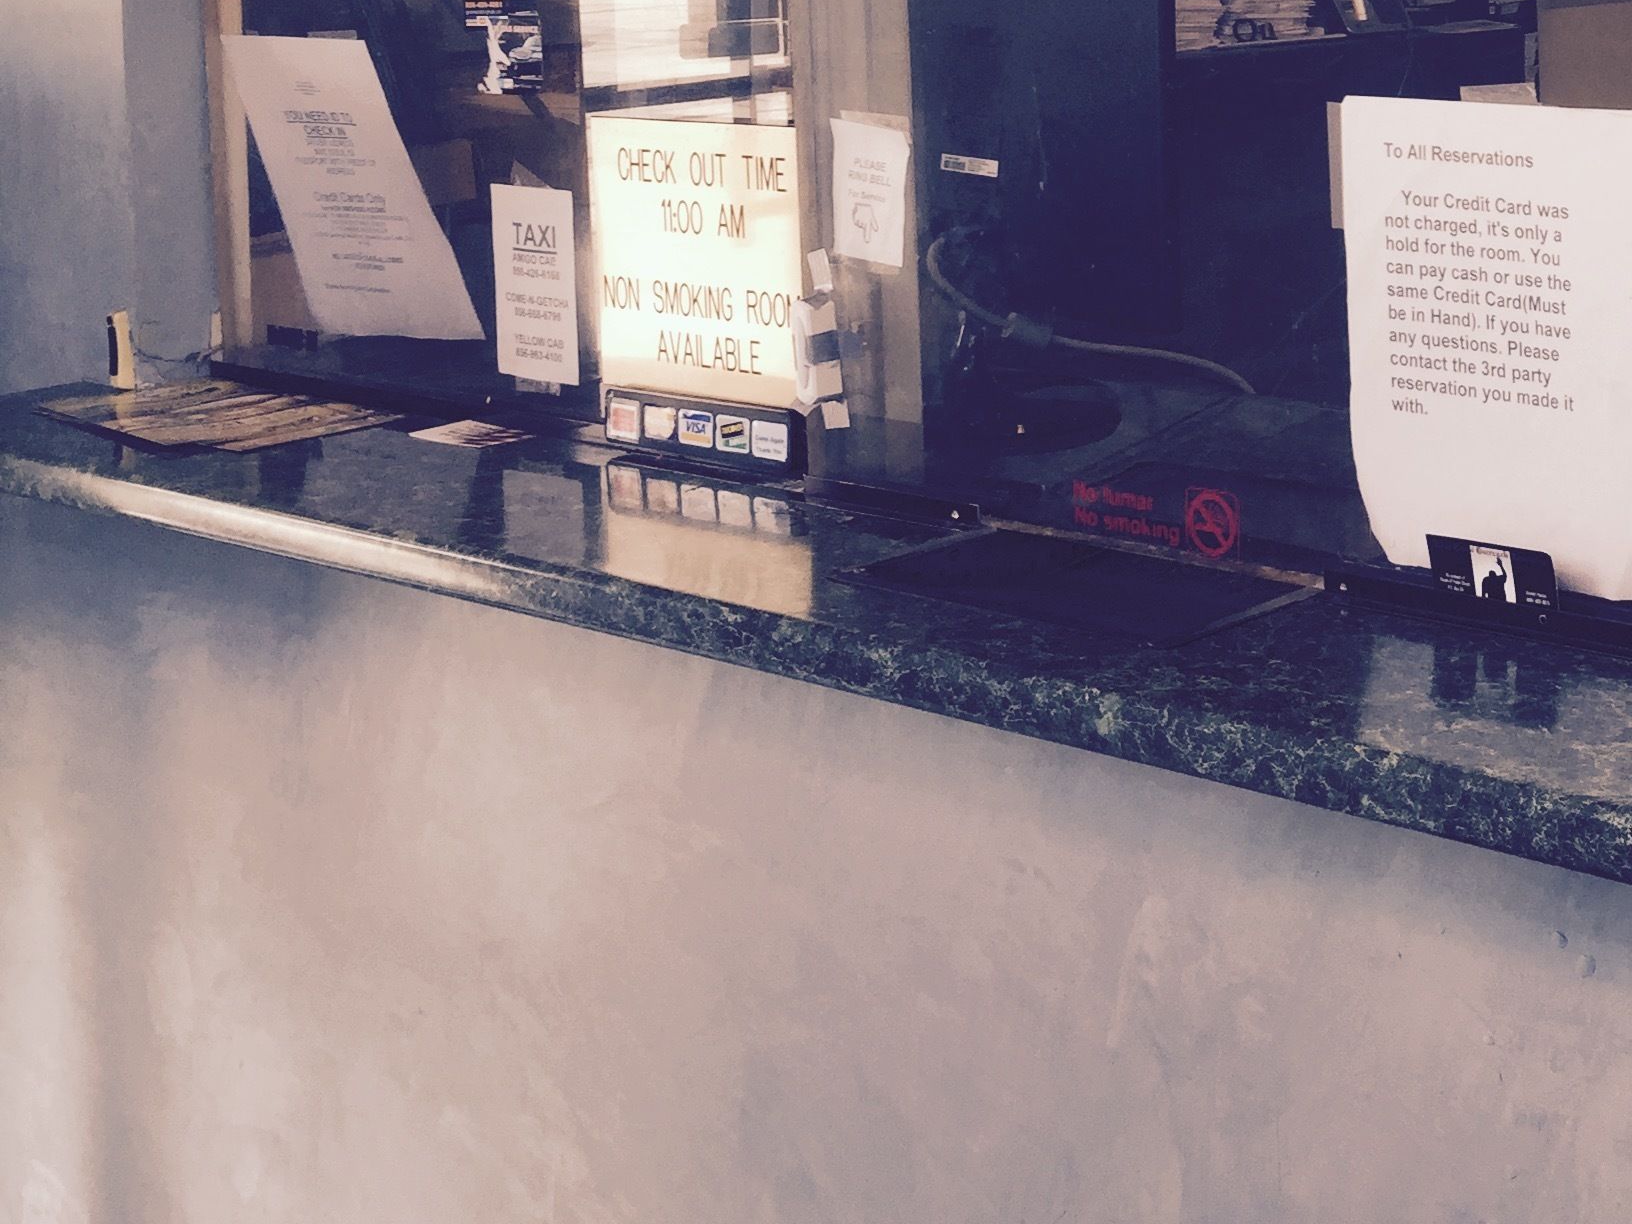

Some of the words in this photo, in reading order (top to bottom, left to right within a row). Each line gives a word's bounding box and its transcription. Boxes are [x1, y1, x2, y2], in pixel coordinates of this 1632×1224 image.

[304, 124, 334, 136] CHECK
[617, 147, 677, 184] CHECK
[689, 151, 727, 188] OUT
[741, 155, 788, 193] TIME
[853, 157, 887, 172] PLEASE
[1384, 142, 1403, 159] To
[1408, 144, 1427, 161] All
[1431, 146, 1534, 168] Reservations
[848, 169, 869, 184] RING
[870, 172, 891, 188] BELL
[661, 199, 703, 235] 11:00
[718, 203, 746, 239] AM
[1401, 190, 1439, 208] Your
[1443, 193, 1490, 213] Credit
[1495, 197, 1532, 216] Card
[1536, 204, 1569, 219] was
[512, 222, 556, 249] TAXI
[1385, 215, 1410, 229] not
[1414, 215, 1483, 237] charged,
[1487, 221, 1510, 237] it's
[1514, 225, 1548, 245] only
[1553, 230, 1562, 243] a
[1386, 235, 1420, 253] hold
[1424, 238, 1447, 256] for
[1450, 241, 1476, 258] the
[1480, 248, 1526, 263] room.
[1530, 247, 1561, 266] You
[1386, 261, 1414, 276] can
[1419, 264, 1447, 282] pay
[1451, 266, 1488, 283] cash
[1493, 271, 1510, 284] or
[1514, 274, 1543, 288] use
[1547, 274, 1572, 292] the
[603, 274, 641, 311] NON
[652, 279, 734, 322] SMOKING
[1387, 284, 1429, 300] same
[1433, 285, 1480, 306] Credit
[1485, 290, 1567, 316] Card(Must
[1388, 304, 1407, 321] be
[1411, 306, 1425, 323] in
[1430, 309, 1481, 332] Hand).
[1486, 314, 1496, 330] If
[1500, 319, 1530, 336] you
[1534, 320, 1572, 340] have
[514, 333, 545, 347] YELLOW
[547, 337, 564, 349] CAB
[657, 330, 763, 376] AVAILABLE
[1389, 330, 1417, 348] any
[1421, 333, 1503, 356] questions.
[1508, 340, 1560, 362] Please
[1390, 352, 1448, 372] contact
[1452, 357, 1477, 374] the
[1481, 360, 1507, 378] 3rd
[1511, 367, 1552, 388] party
[1391, 376, 1477, 398] reservation
[1482, 387, 1512, 404] you
[1516, 391, 1559, 410] made
[1564, 394, 1575, 412] it
[1391, 397, 1429, 416] with.
[686, 421, 706, 435] VISA
[1073, 479, 1098, 503] No
[1074, 506, 1098, 526] No
[1103, 515, 1180, 547] smoking
